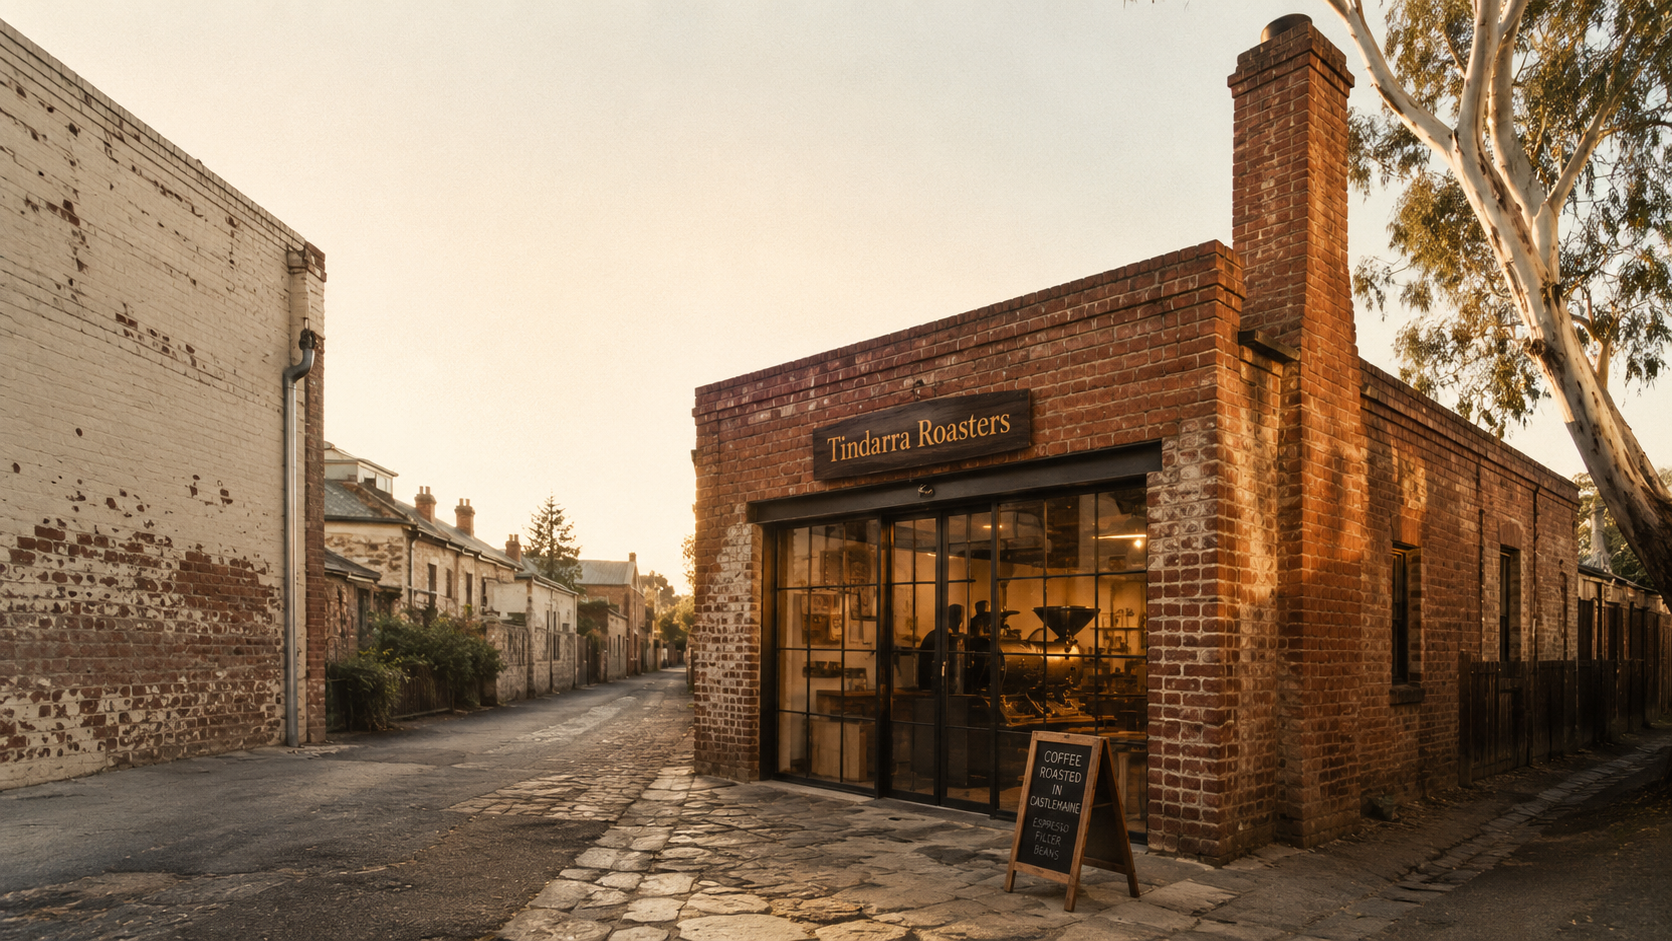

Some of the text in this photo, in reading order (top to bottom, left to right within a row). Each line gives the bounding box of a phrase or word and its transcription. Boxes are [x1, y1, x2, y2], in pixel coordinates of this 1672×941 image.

[827, 413, 1011, 462] Tindarra Roasters
[1044, 750, 1082, 767] COFFEE
[1040, 766, 1082, 783] ROASTED
[1051, 784, 1063, 796] IN
[1030, 795, 1080, 814] CASTLEMAINE
[1034, 844, 1059, 860] BEANS
